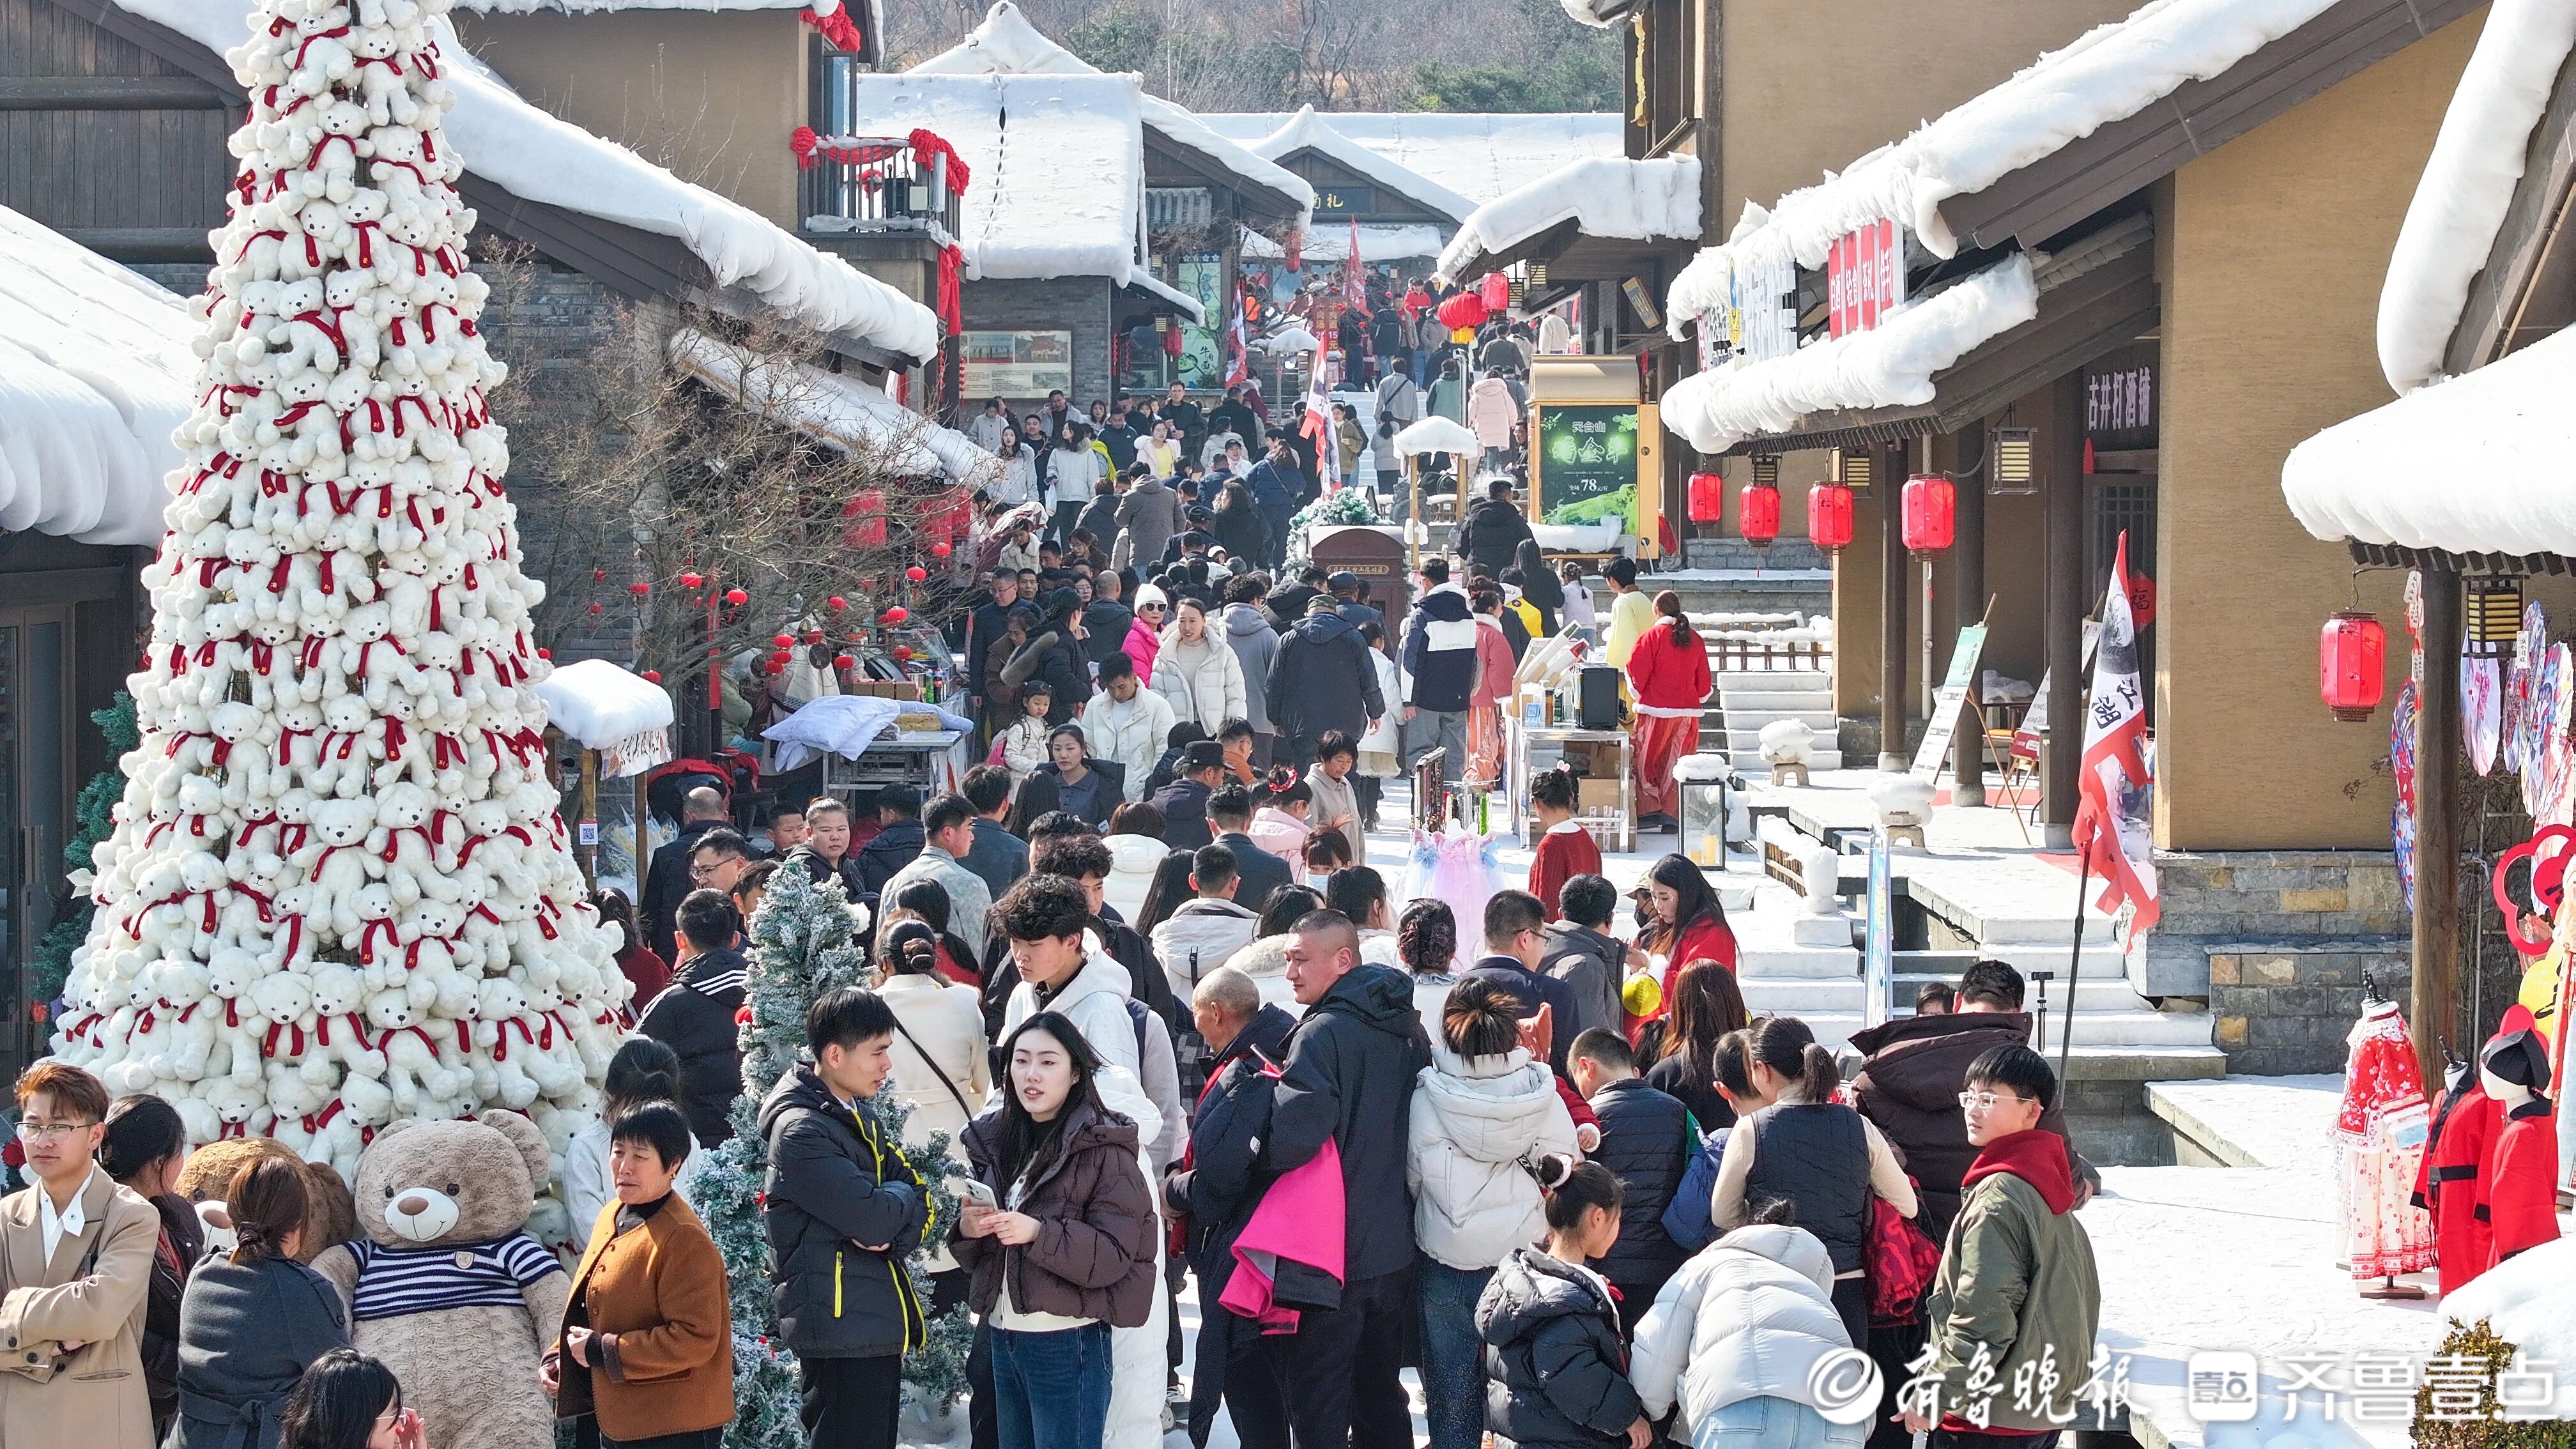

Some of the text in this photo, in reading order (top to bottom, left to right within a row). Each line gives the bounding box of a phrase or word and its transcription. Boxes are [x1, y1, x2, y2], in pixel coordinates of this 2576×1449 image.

[1862, 259, 1874, 302] 茶礼
[1572, 421, 1606, 433] 天台山
[2091, 677, 2138, 730] 江湖
